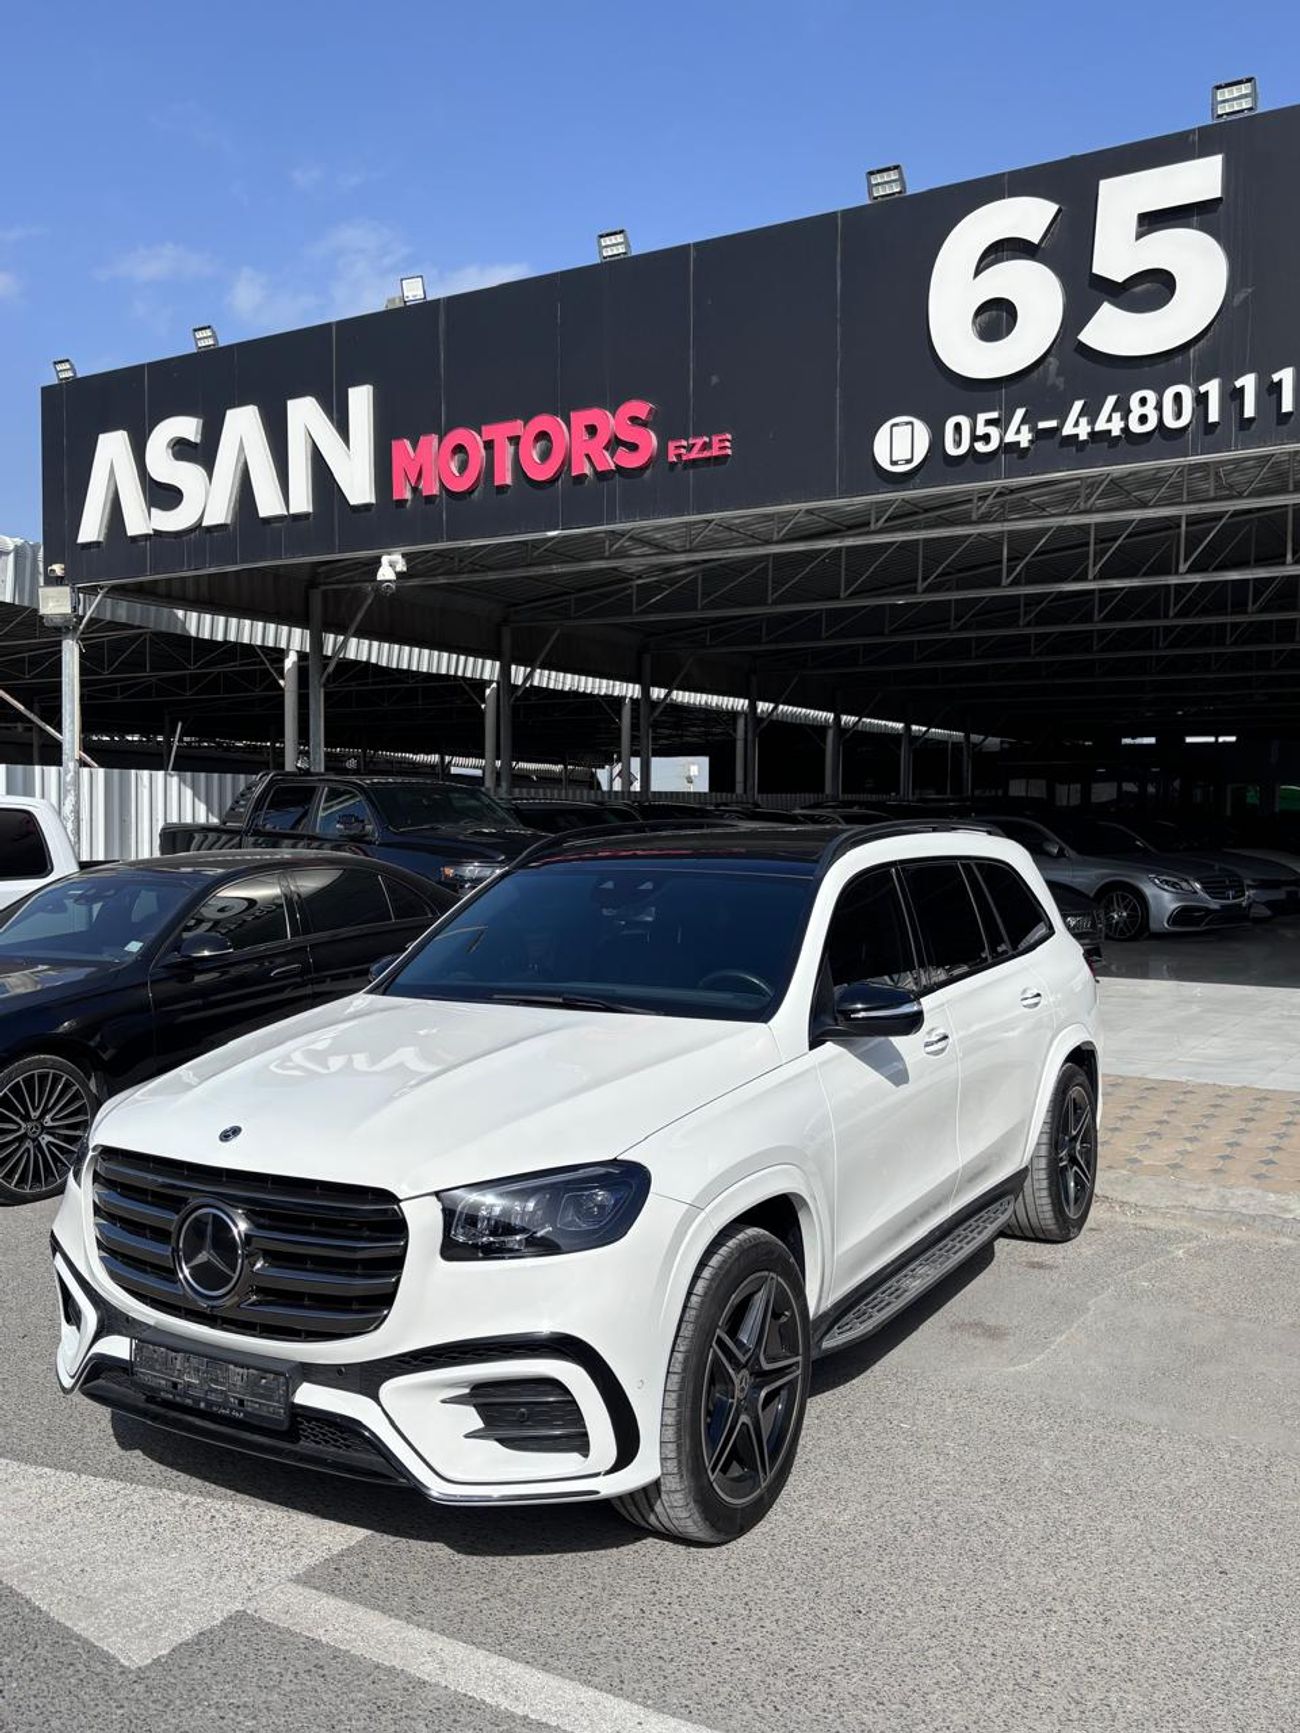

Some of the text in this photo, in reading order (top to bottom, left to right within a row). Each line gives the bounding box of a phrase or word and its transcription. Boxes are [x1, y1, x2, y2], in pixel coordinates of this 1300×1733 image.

[928, 154, 1228, 379] 65
[76, 384, 376, 545] ASAN
[391, 399, 658, 500] MOTORS
[943, 367, 1295, 456] 054-4480111
